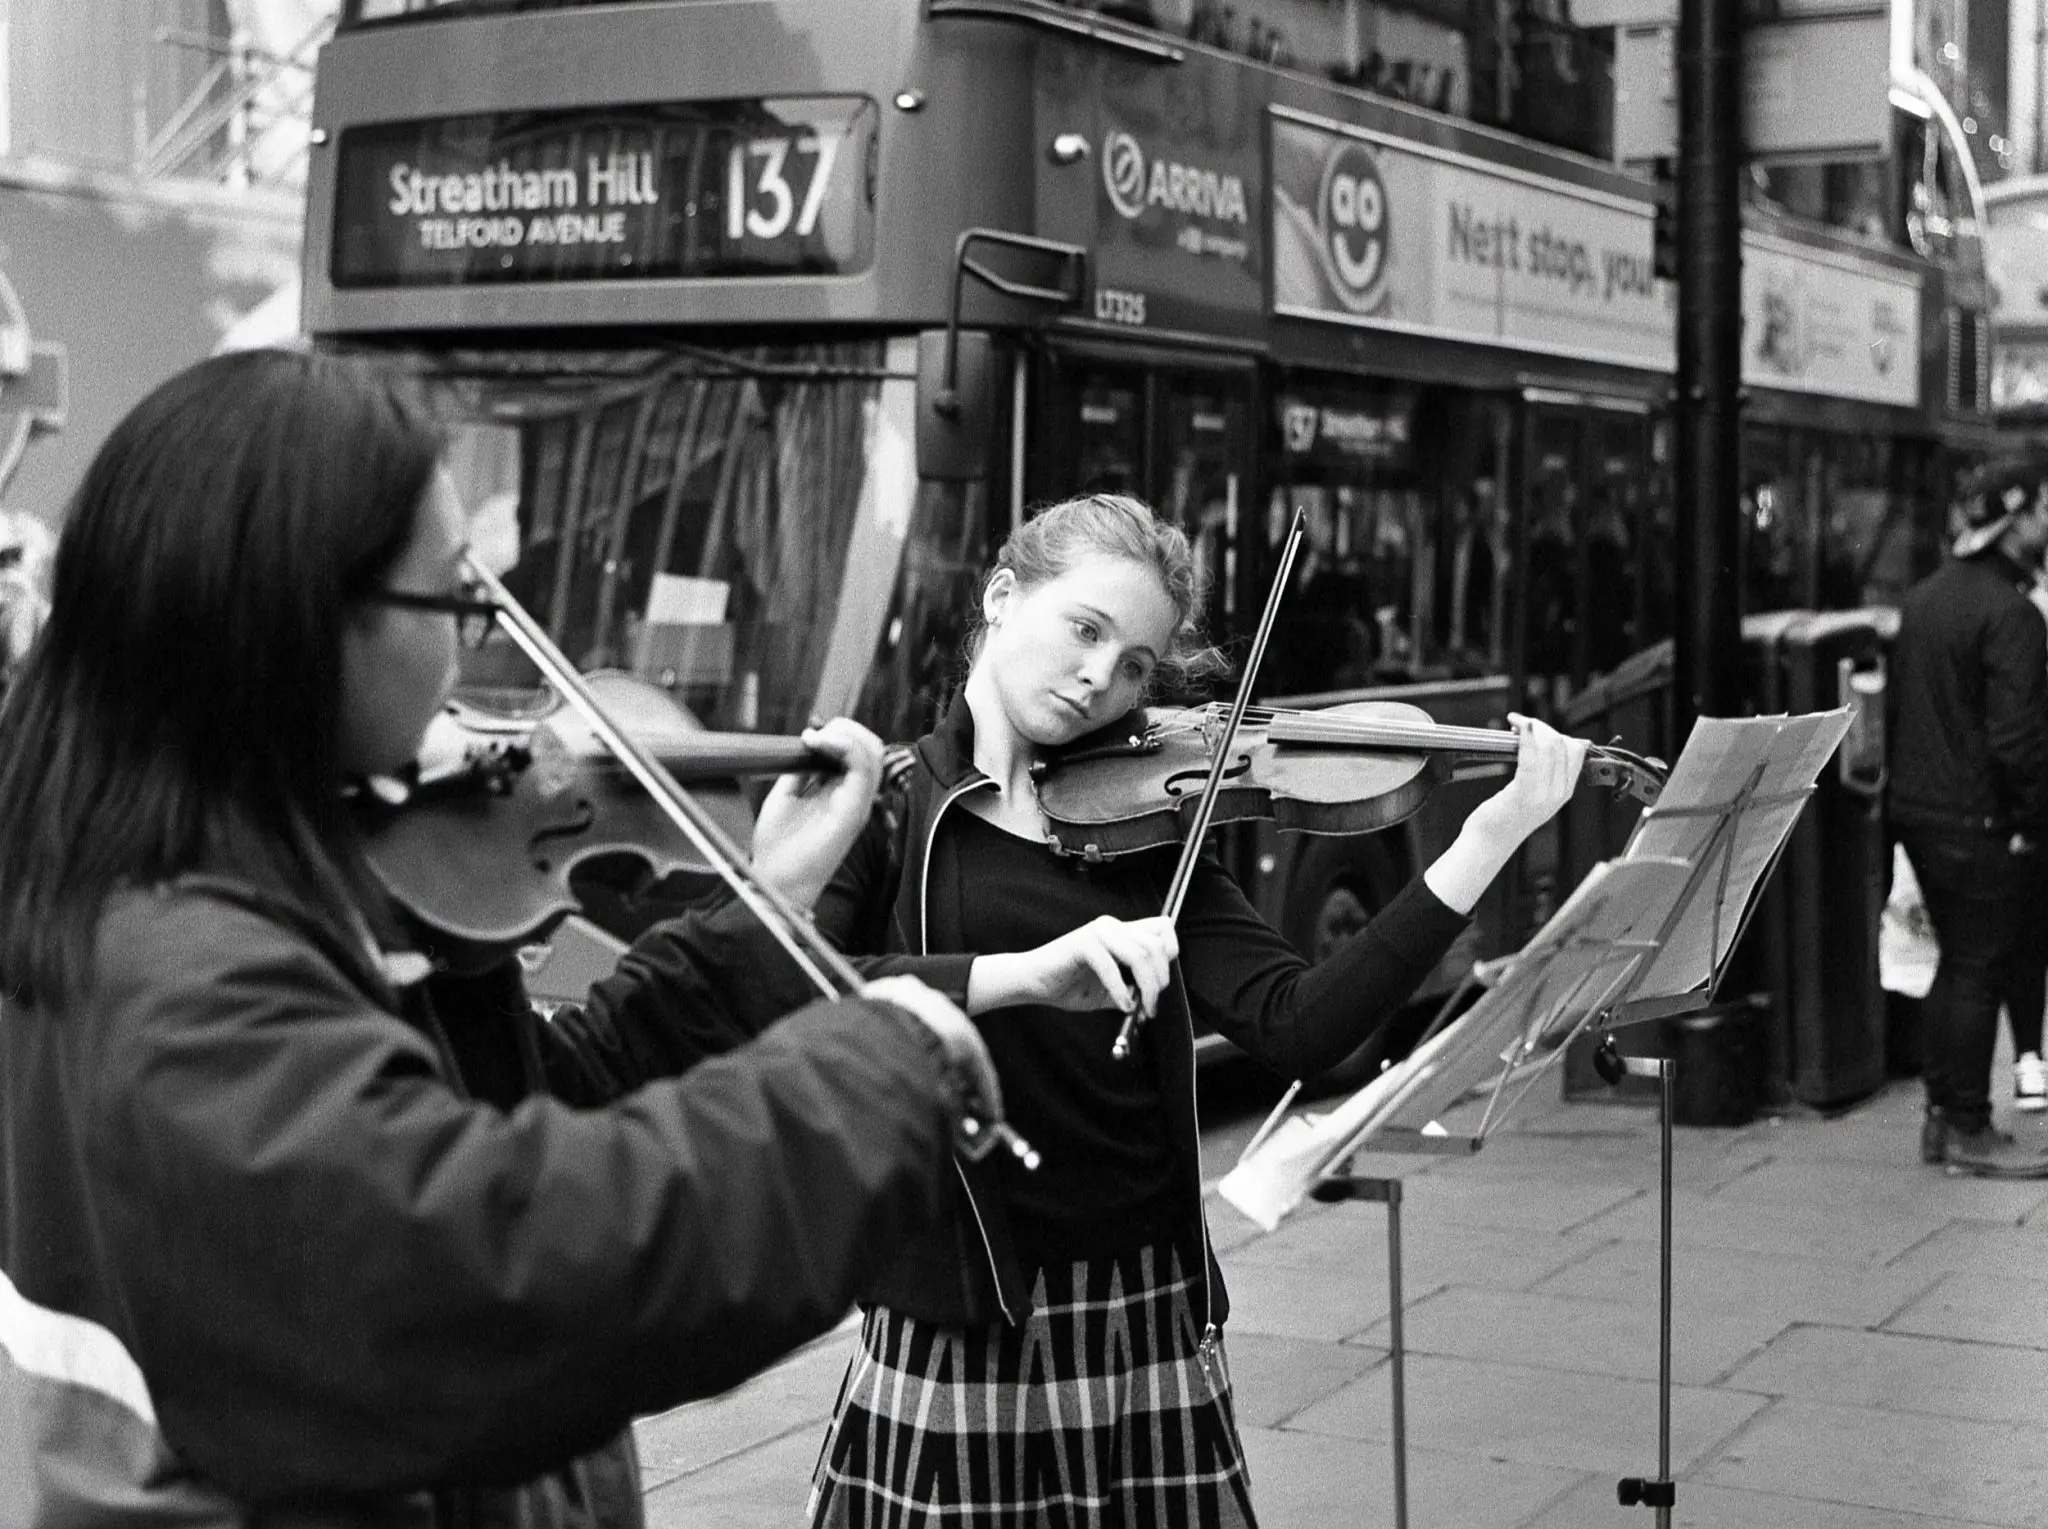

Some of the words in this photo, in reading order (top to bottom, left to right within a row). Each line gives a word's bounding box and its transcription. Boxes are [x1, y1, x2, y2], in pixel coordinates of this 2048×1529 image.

[390, 158, 577, 215] Streatham
[588, 152, 658, 206] Hill
[727, 137, 838, 237] 137
[1147, 161, 1247, 224] ARRIVA
[419, 220, 524, 249] TELFORD
[527, 212, 626, 244] AVENUE
